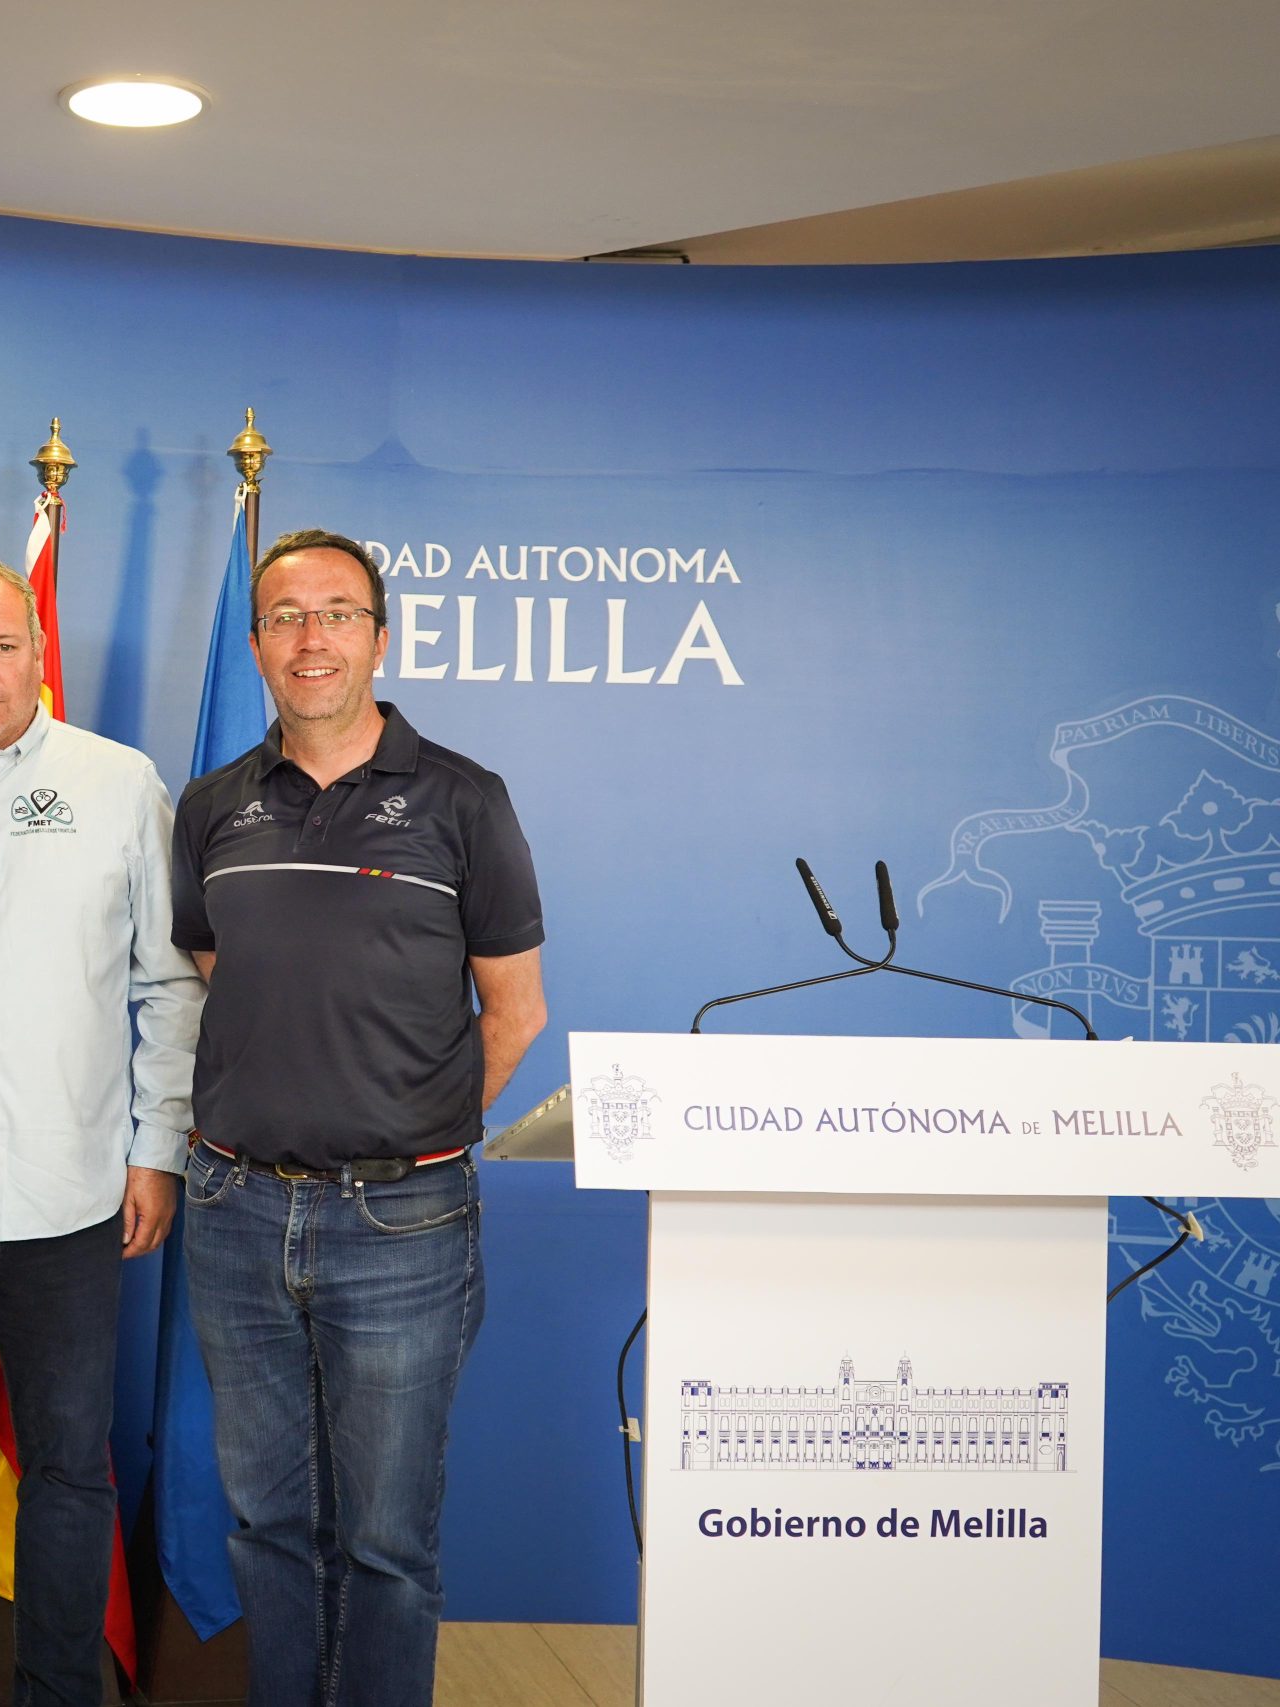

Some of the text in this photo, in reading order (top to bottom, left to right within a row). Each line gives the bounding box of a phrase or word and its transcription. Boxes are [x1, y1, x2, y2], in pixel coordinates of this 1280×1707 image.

[465, 545, 742, 584] AUTONOMA
[374, 593, 745, 686] ELILLA
[1059, 704, 1169, 744] PATRIAM
[1194, 709, 1280, 767] LIBERIS
[28, 819, 52, 828] FMET
[956, 806, 1080, 856] PRAEFERRE
[1020, 969, 1073, 996] NON
[1085, 969, 1141, 1003] PLVS
[683, 1101, 1183, 1137] CIUDAD AUTÓNOMA DE MELILLA
[698, 1508, 1048, 1539] Gobierno de Melilla
